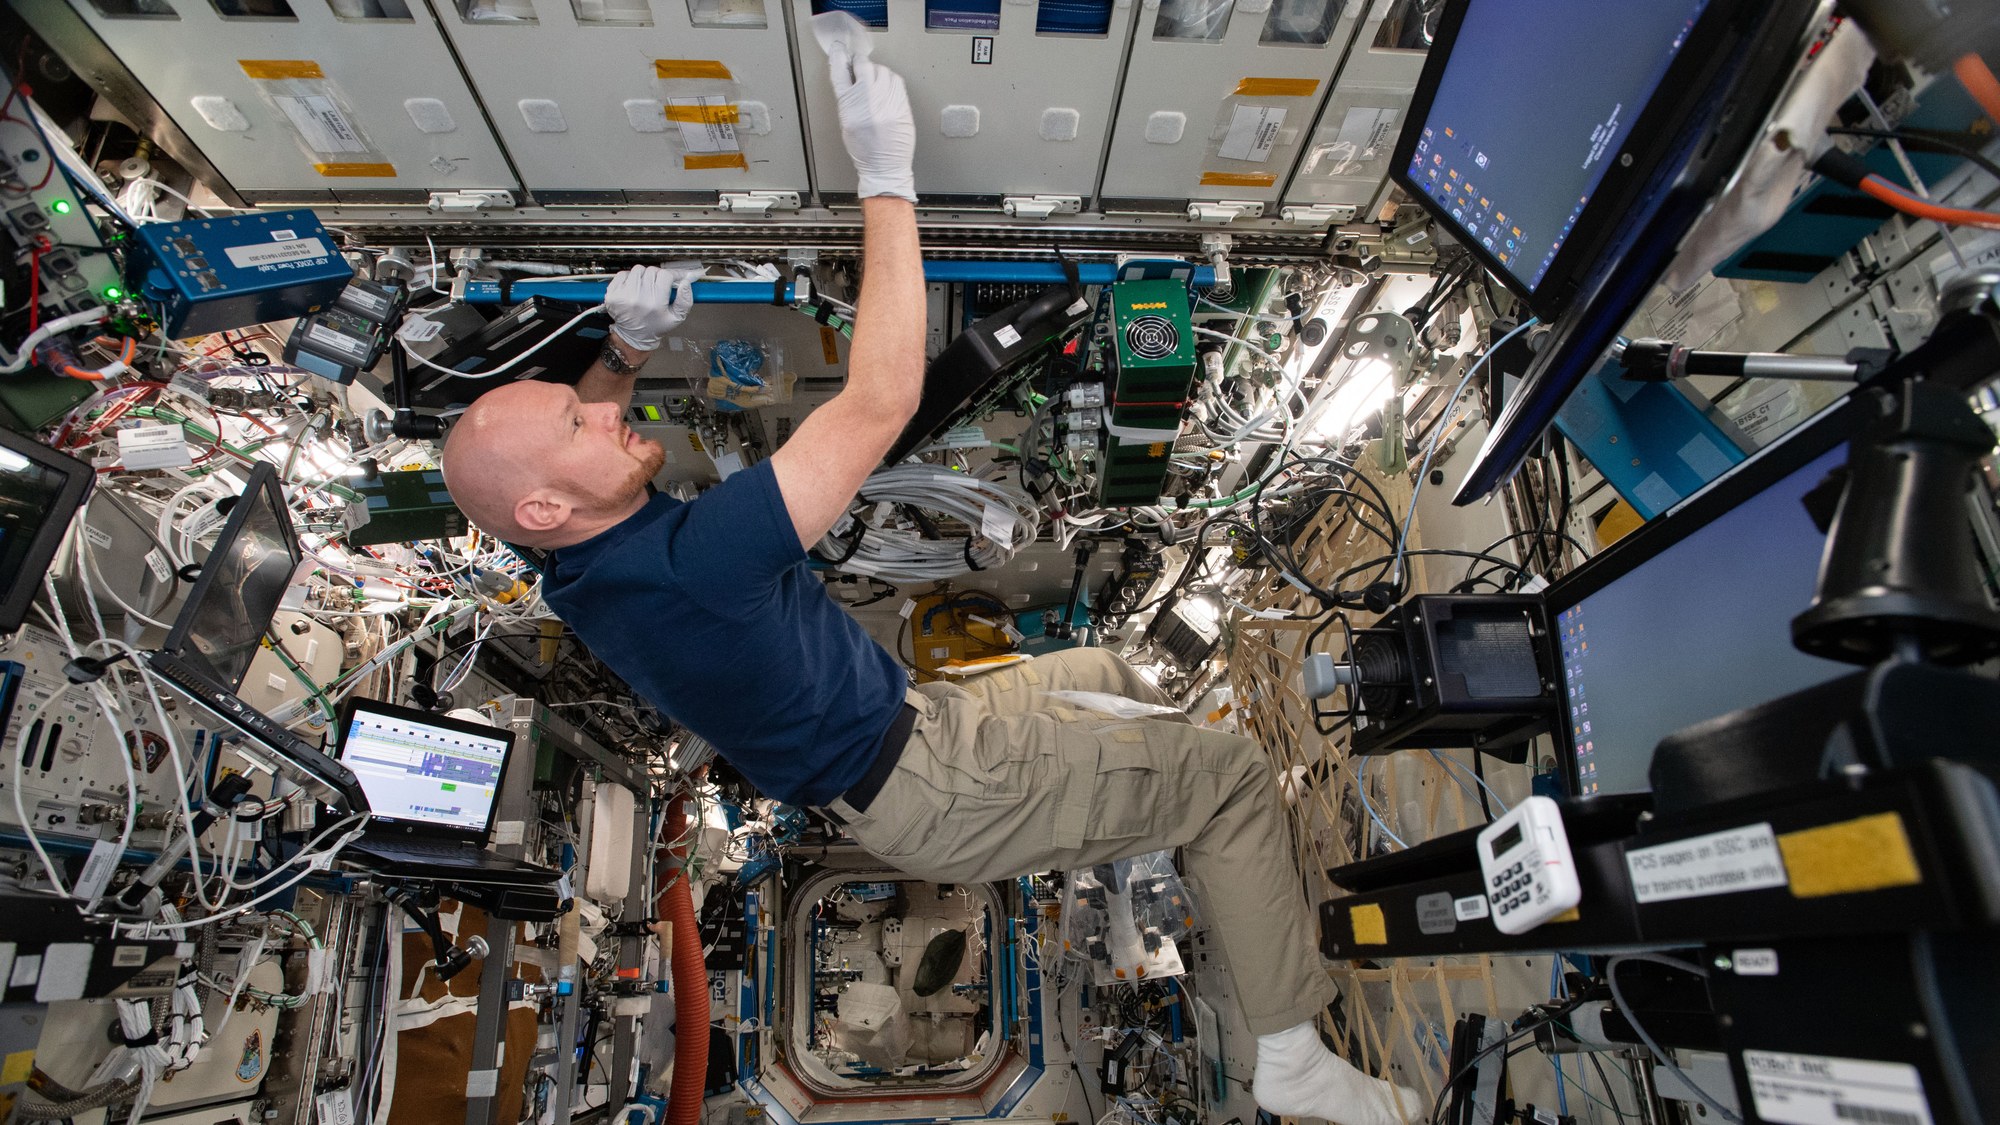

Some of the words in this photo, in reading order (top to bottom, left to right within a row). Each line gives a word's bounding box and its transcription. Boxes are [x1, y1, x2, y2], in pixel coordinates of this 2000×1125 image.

[1734, 404, 1770, 427] B1S5_C1
[85, 526, 110, 542] EXHAUST
[1633, 854, 1658, 869] PCS
[1660, 850, 1694, 867] pages
[1750, 835, 1769, 848] are
[1653, 877, 1695, 892] training
[1698, 870, 1746, 889] purpose
[1752, 863, 1778, 881] only
[458, 885, 482, 899] QUATECH
[714, 970, 726, 1000] POR
